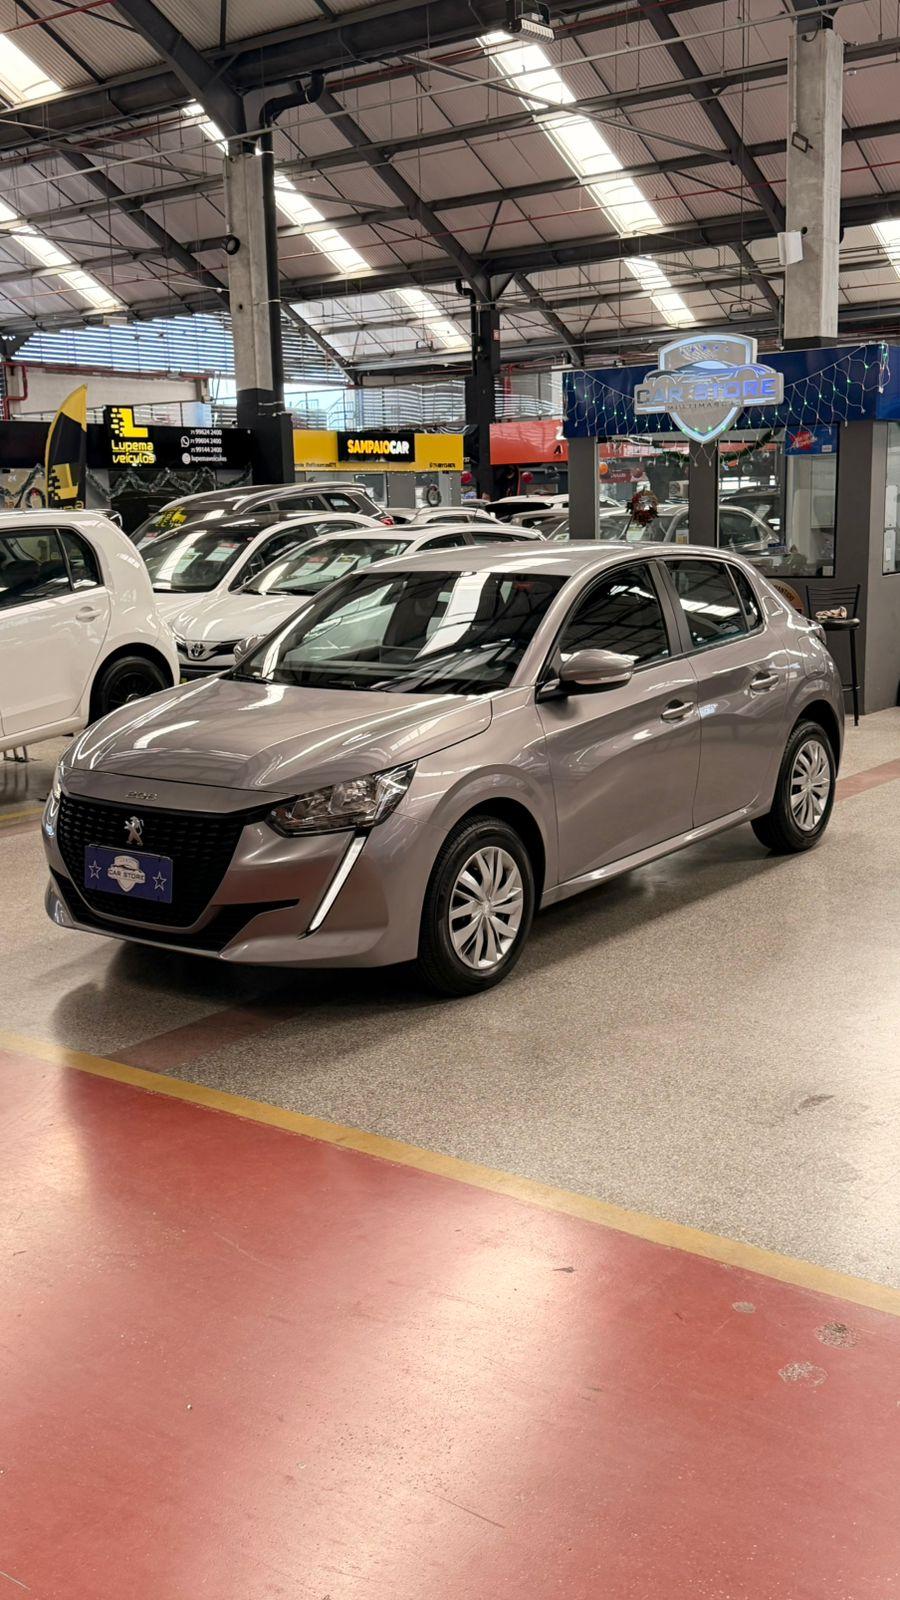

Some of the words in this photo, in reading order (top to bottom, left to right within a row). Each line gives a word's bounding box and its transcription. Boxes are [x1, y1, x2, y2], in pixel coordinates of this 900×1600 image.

[636, 385, 682, 404] CAR
[694, 378, 777, 401] STORE
[111, 440, 154, 451] Lupema
[347, 439, 409, 454] SAMPAIOCAR
[123, 871, 145, 881] STORE
